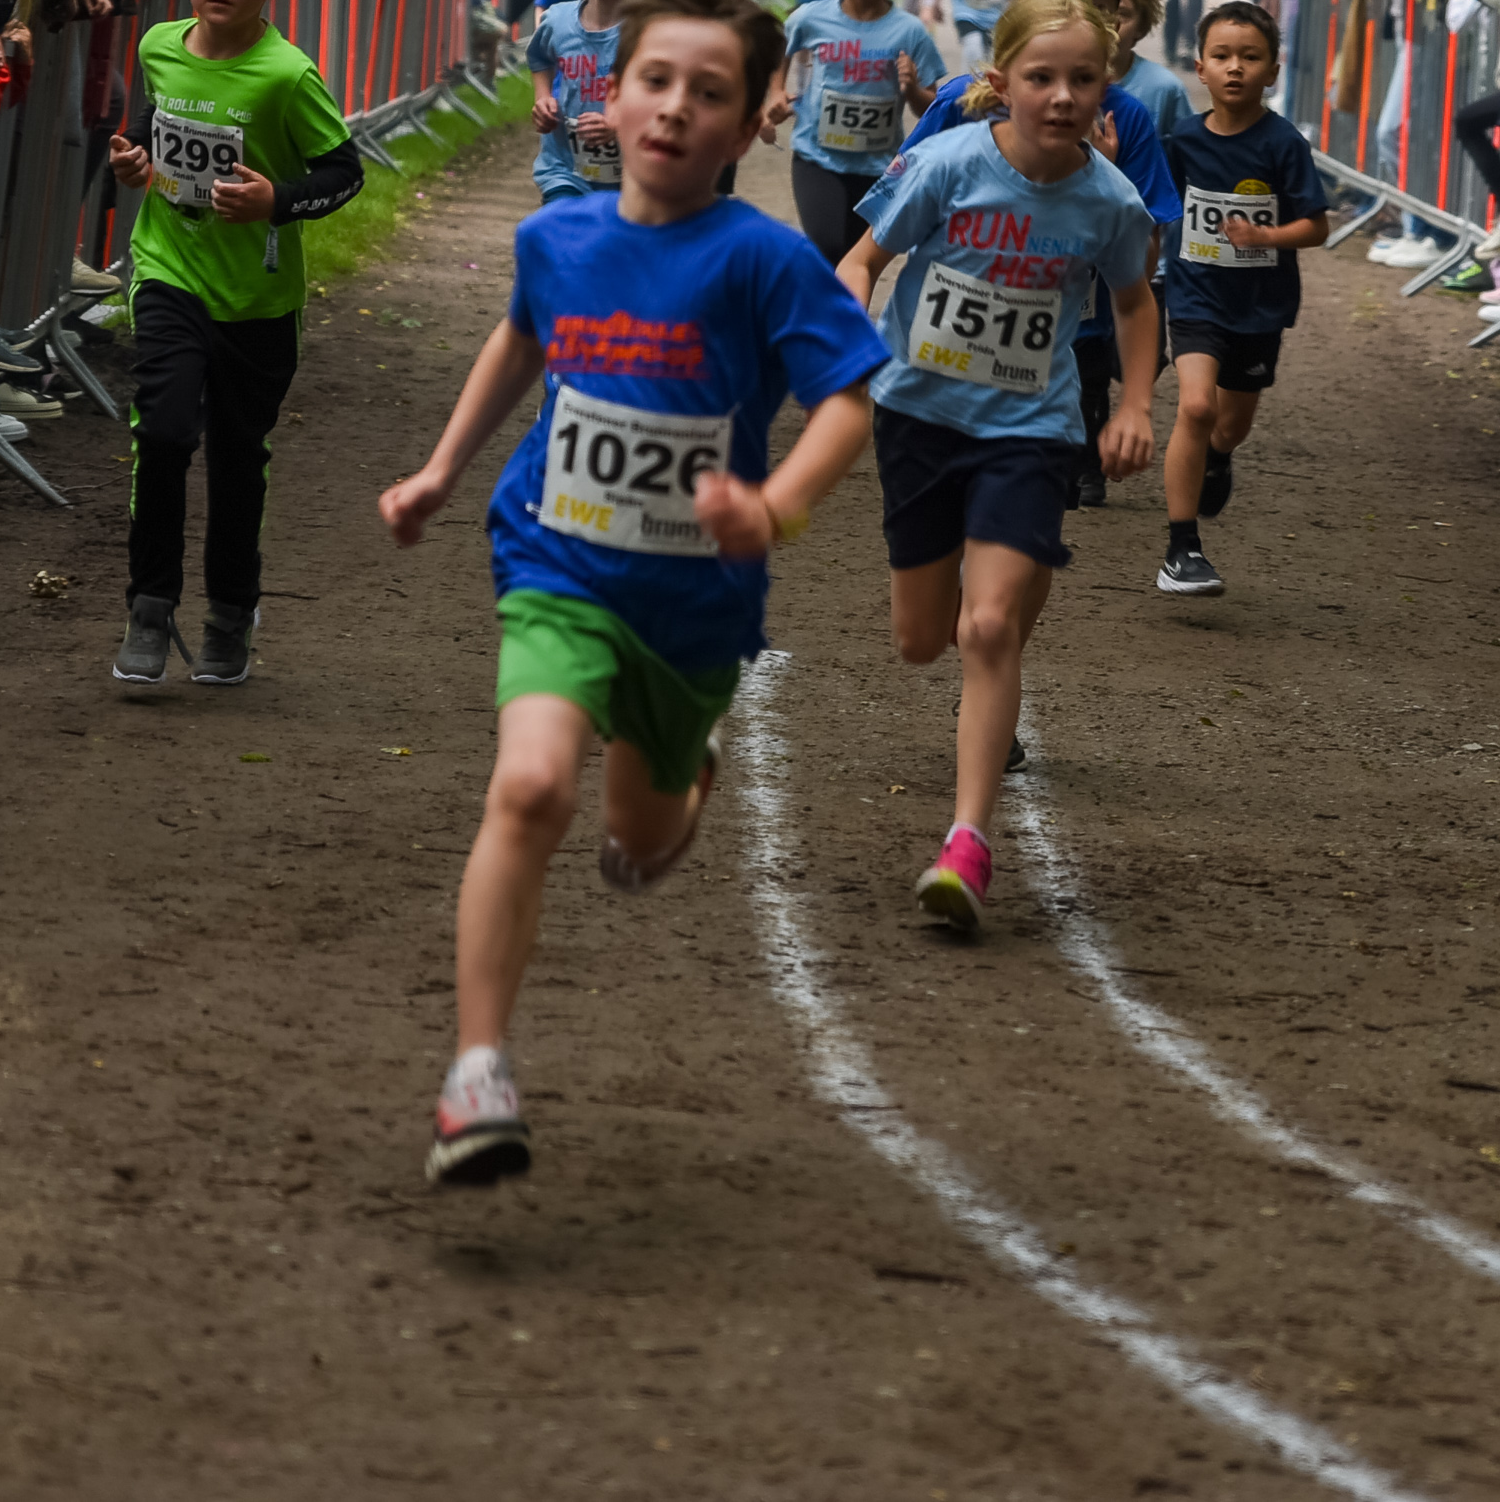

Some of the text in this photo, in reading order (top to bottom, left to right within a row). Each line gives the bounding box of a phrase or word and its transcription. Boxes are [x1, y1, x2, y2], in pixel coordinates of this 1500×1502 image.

[819, 39, 861, 63] RUN
[558, 54, 598, 80] RUN
[167, 98, 215, 113] ROLLING
[824, 103, 894, 129] 1521
[184, 125, 235, 141] Brunnenlauf
[153, 126, 238, 176] 1299
[947, 210, 1032, 252] RUN
[1189, 241, 1220, 259] EWE
[926, 287, 1053, 351] 1518
[917, 341, 972, 372] EWE
[991, 358, 1038, 382] bruns
[557, 422, 719, 496] 1026
[554, 493, 614, 532] EWE
